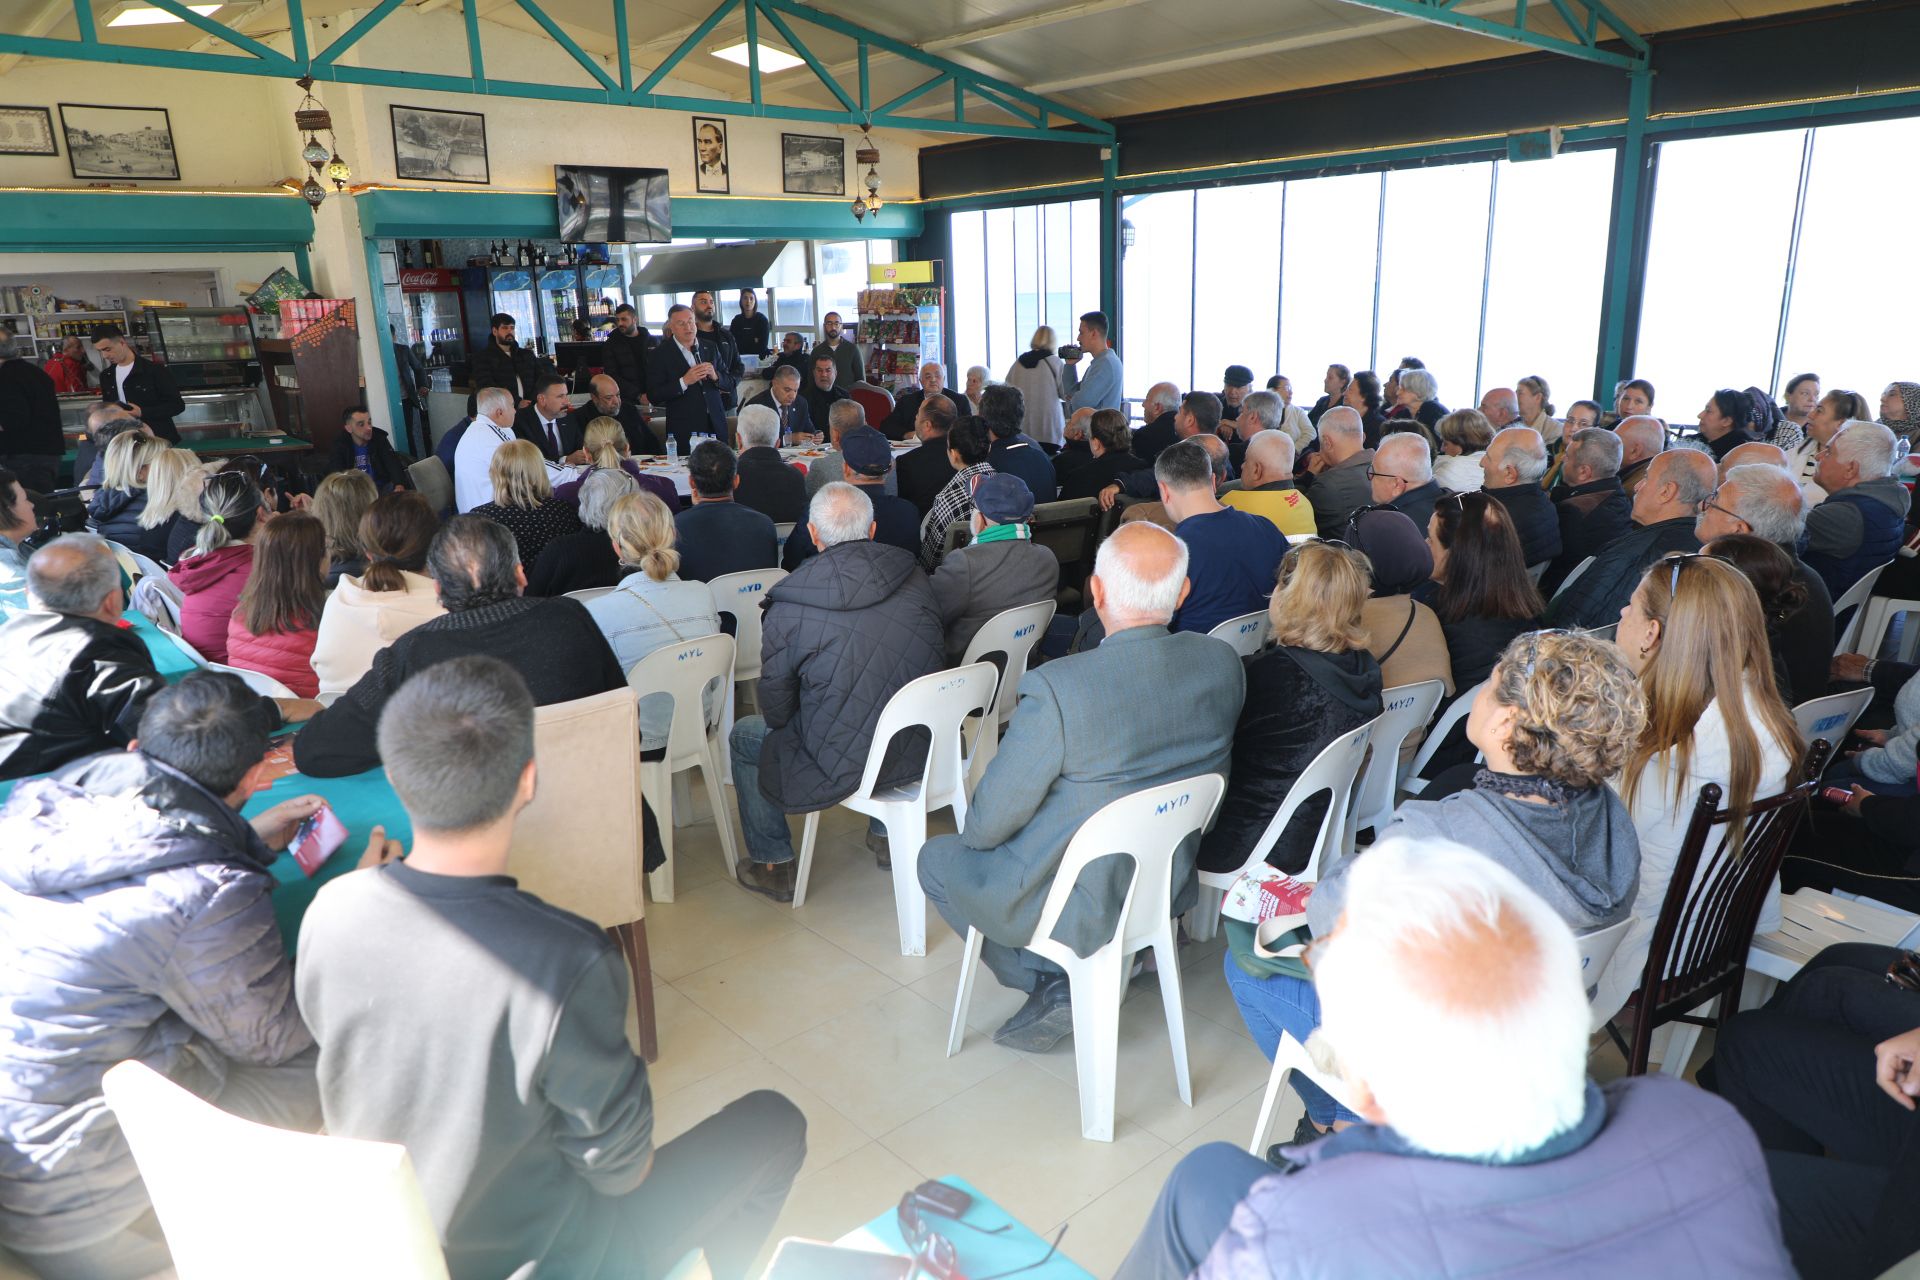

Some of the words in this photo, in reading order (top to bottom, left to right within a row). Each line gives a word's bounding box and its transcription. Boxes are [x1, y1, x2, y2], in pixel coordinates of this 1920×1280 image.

[738, 583, 762, 594] MYD
[1013, 624, 1035, 640] MYD
[1386, 697, 1415, 712] MYD
[1155, 794, 1189, 816] MYD
